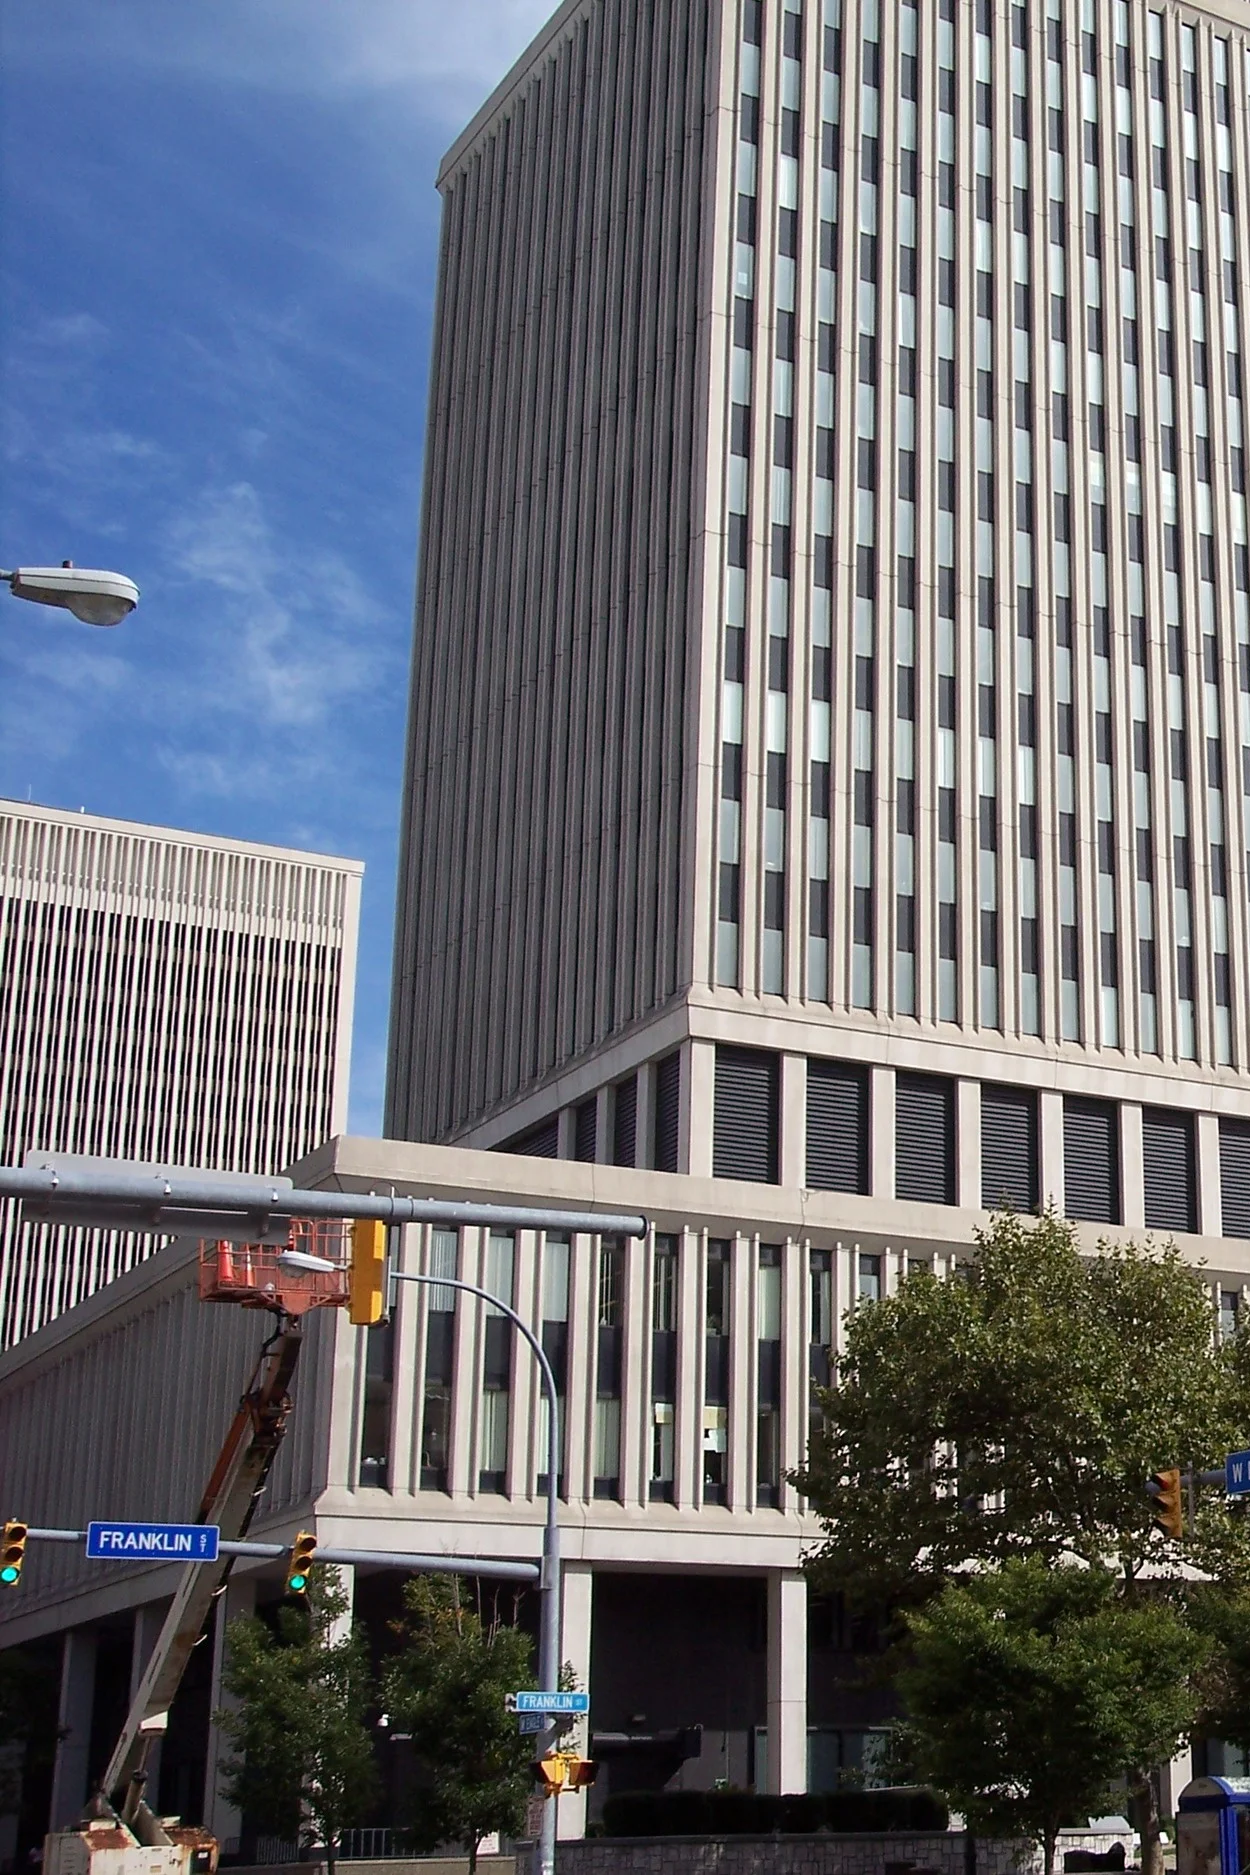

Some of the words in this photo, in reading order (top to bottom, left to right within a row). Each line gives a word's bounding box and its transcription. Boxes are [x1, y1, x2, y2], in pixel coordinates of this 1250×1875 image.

[1232, 1463, 1243, 1483] W
[100, 1531, 191, 1551] FRANKLIN
[522, 1696, 573, 1708] FRANKLIN
